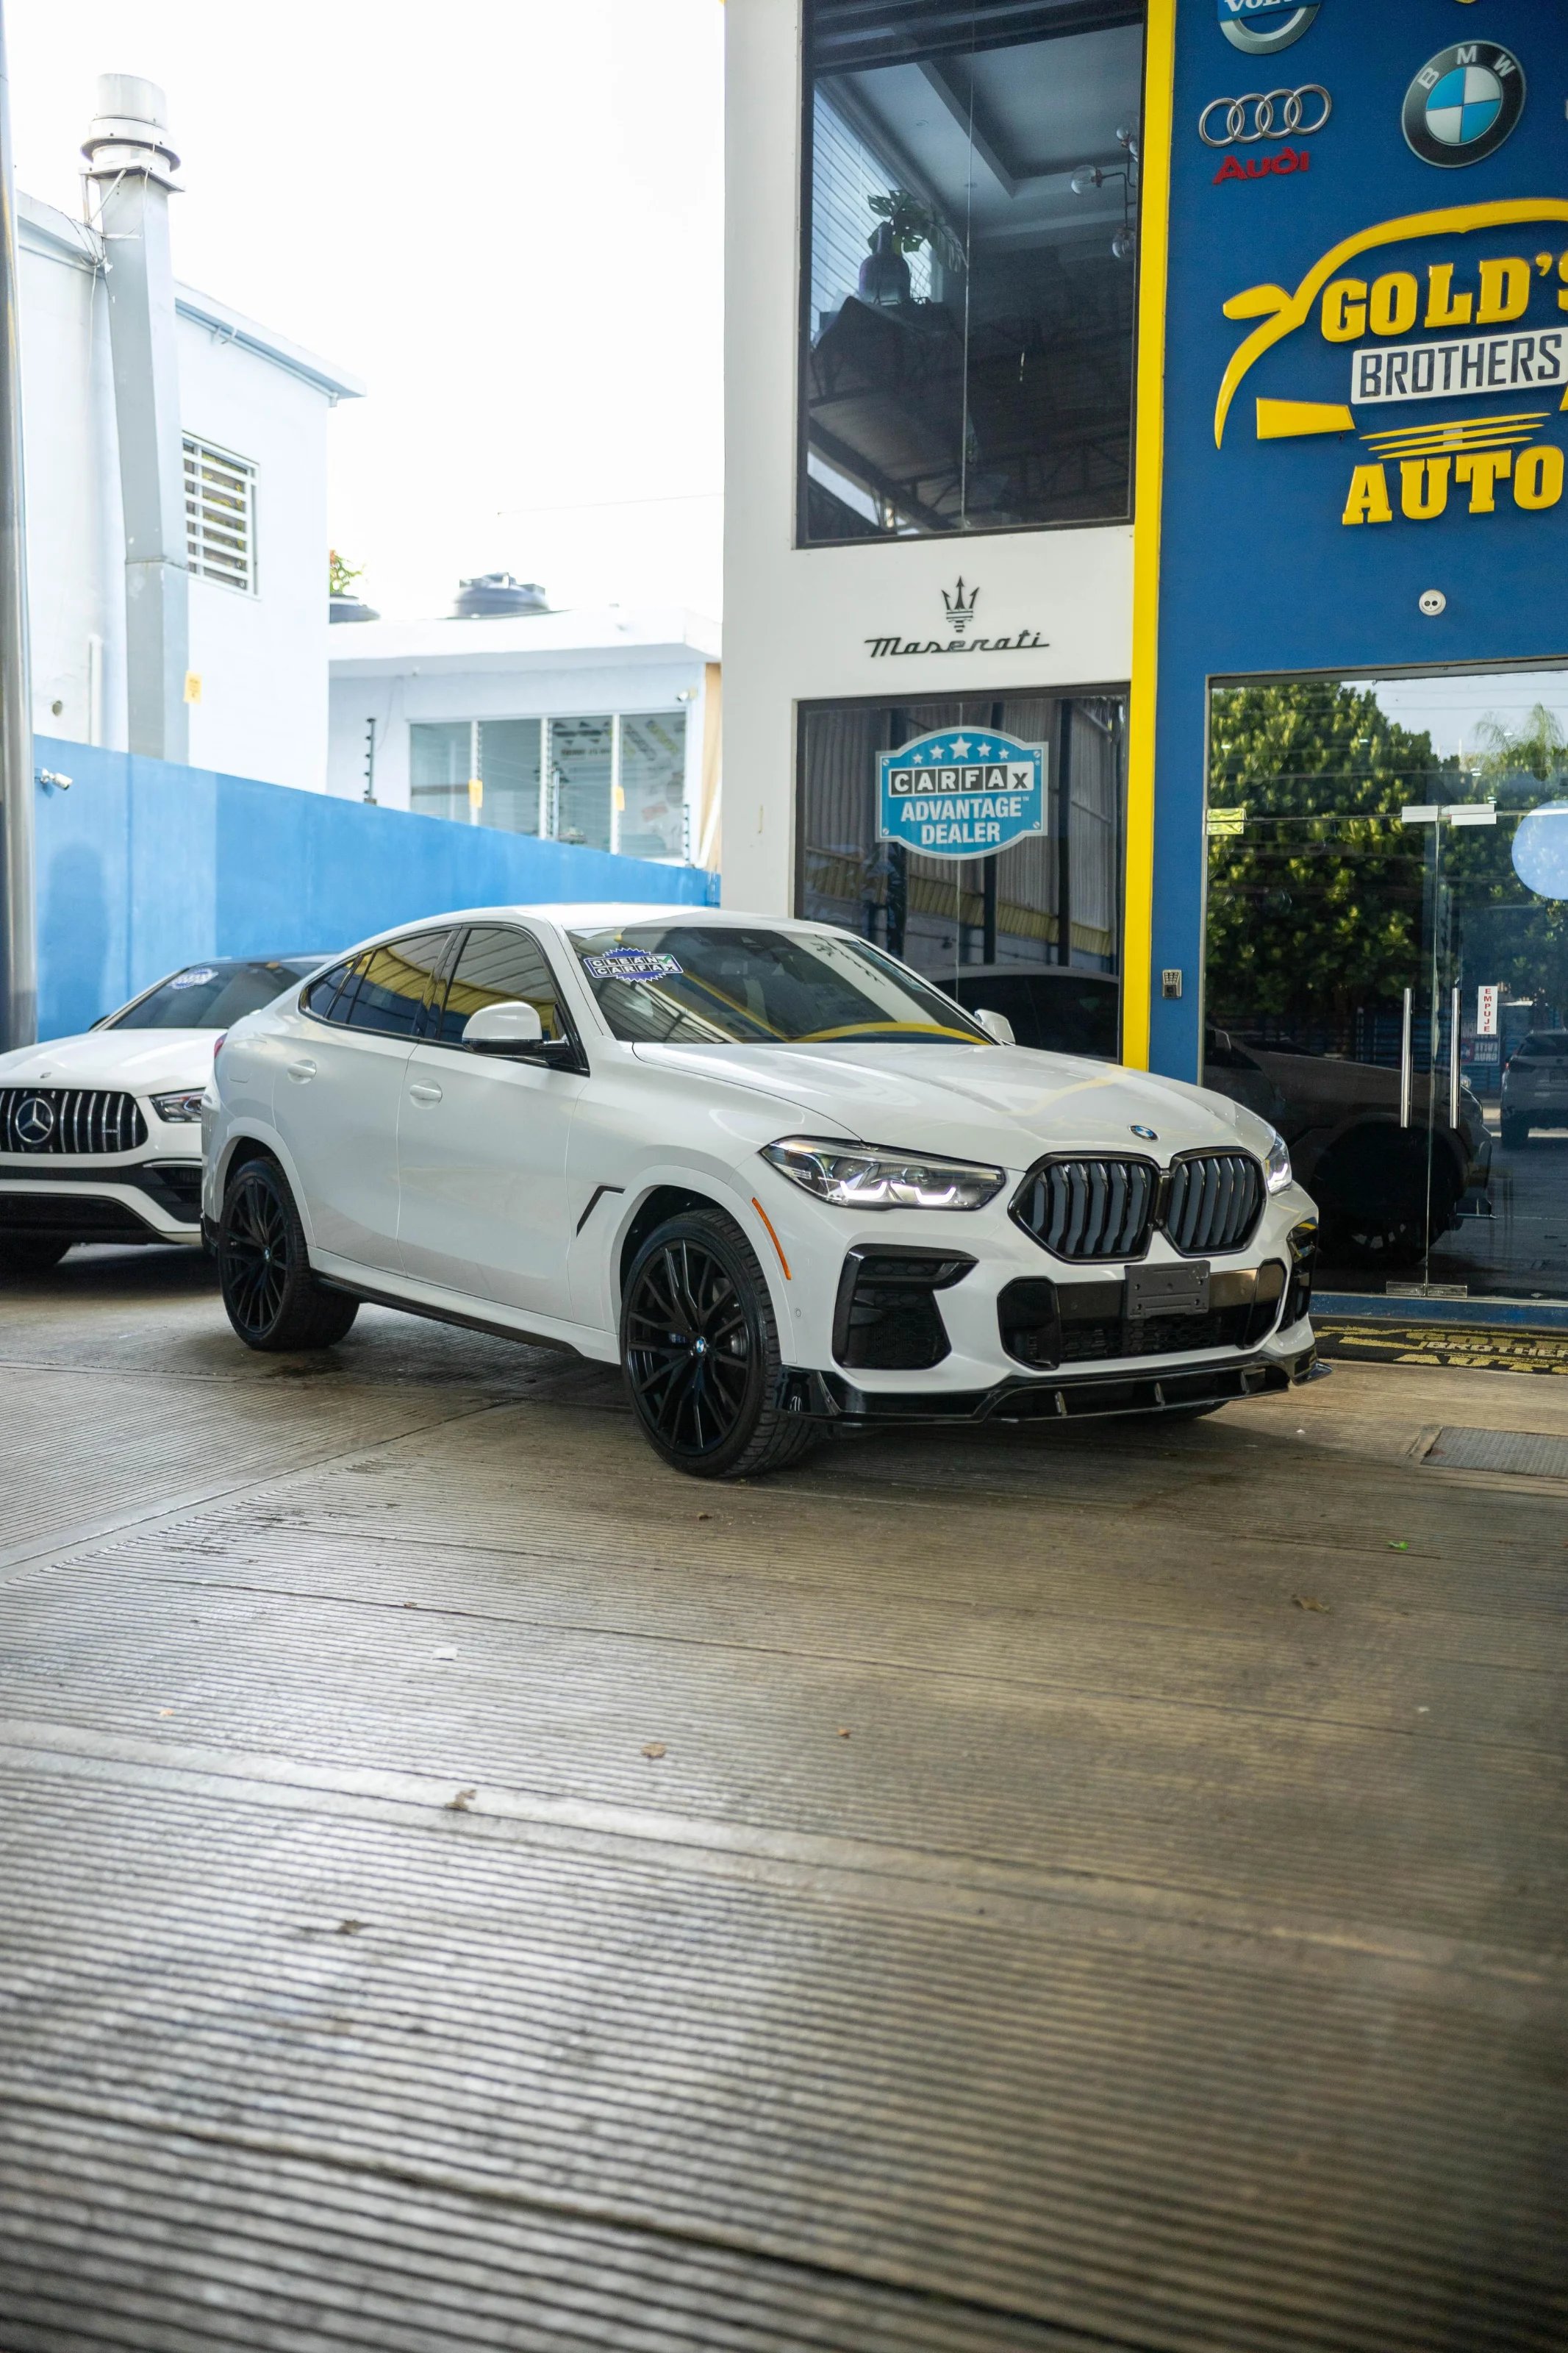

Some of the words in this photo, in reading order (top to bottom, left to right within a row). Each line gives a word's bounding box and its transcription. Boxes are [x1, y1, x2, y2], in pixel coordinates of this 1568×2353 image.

[1224, 0, 1292, 12] VOL
[1417, 46, 1517, 90] BMW
[1212, 146, 1309, 185] Audi
[1321, 249, 1568, 343] GOLD'
[1359, 333, 1561, 399] BROTHERS
[1342, 445, 1564, 525] AUTO
[864, 629, 1050, 657] Maserati
[894, 768, 1028, 792] CARFAX
[921, 824, 1000, 845] DEALER
[592, 956, 658, 968] CLEAN
[596, 964, 676, 975] CARFAX
[1483, 988, 1492, 1032] EMPUJE
